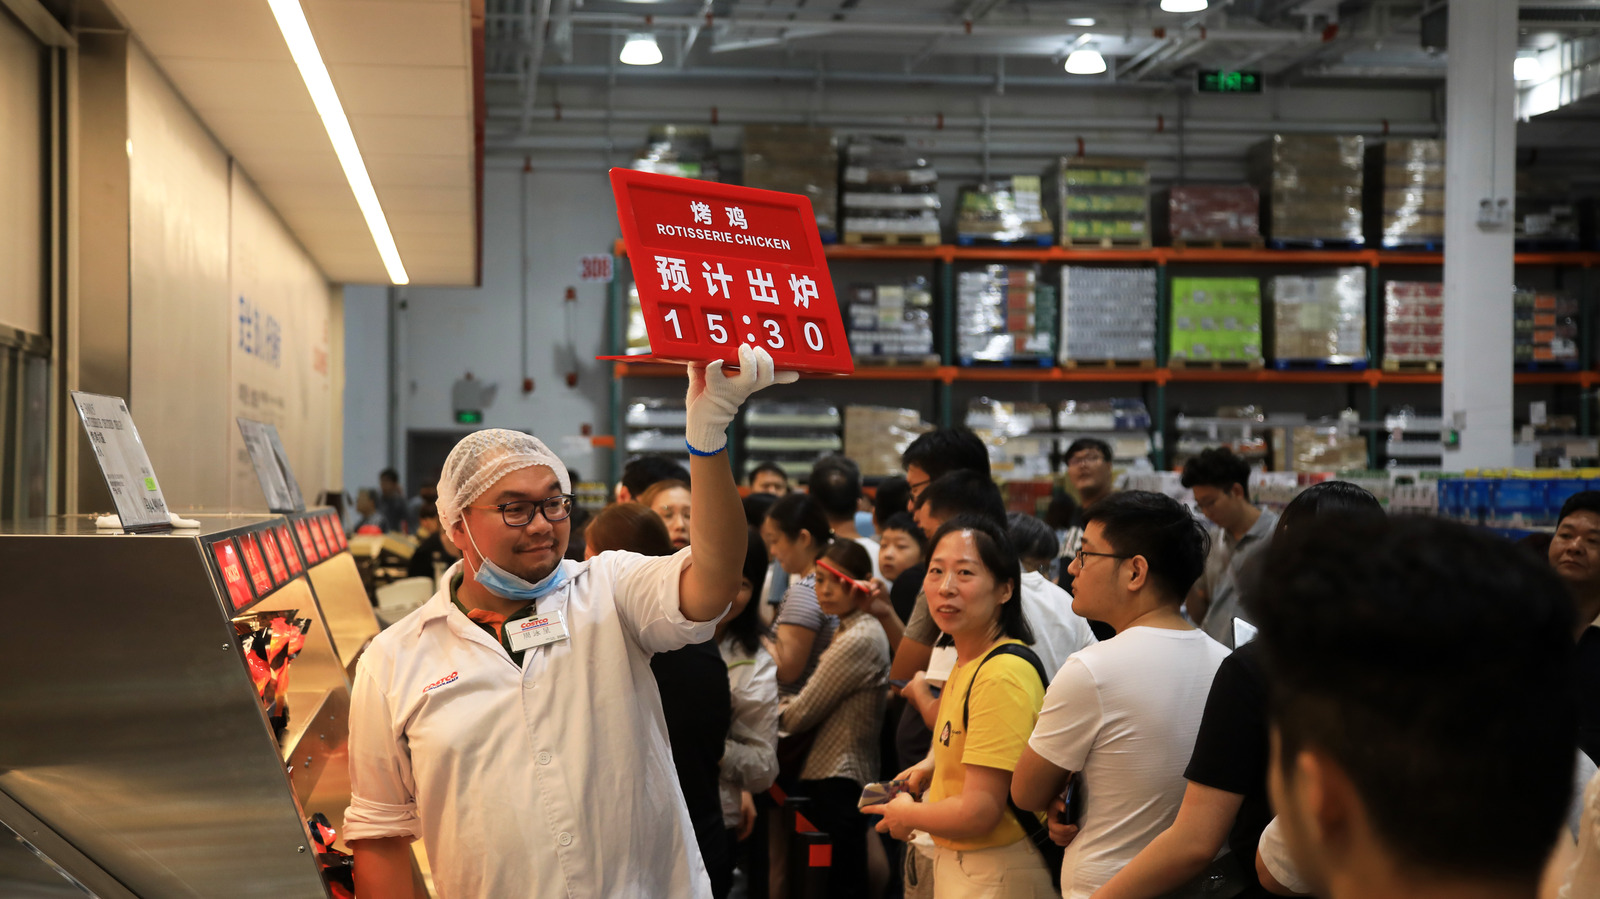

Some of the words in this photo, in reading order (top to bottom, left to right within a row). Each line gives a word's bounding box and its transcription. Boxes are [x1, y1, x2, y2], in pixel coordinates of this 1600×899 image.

[690, 201, 748, 229] 烤鸡
[656, 223, 734, 244] ROTISSERIE
[735, 233, 791, 250] CHICKEN
[654, 255, 819, 309] 预计出炉
[664, 309, 824, 351] 15:30
